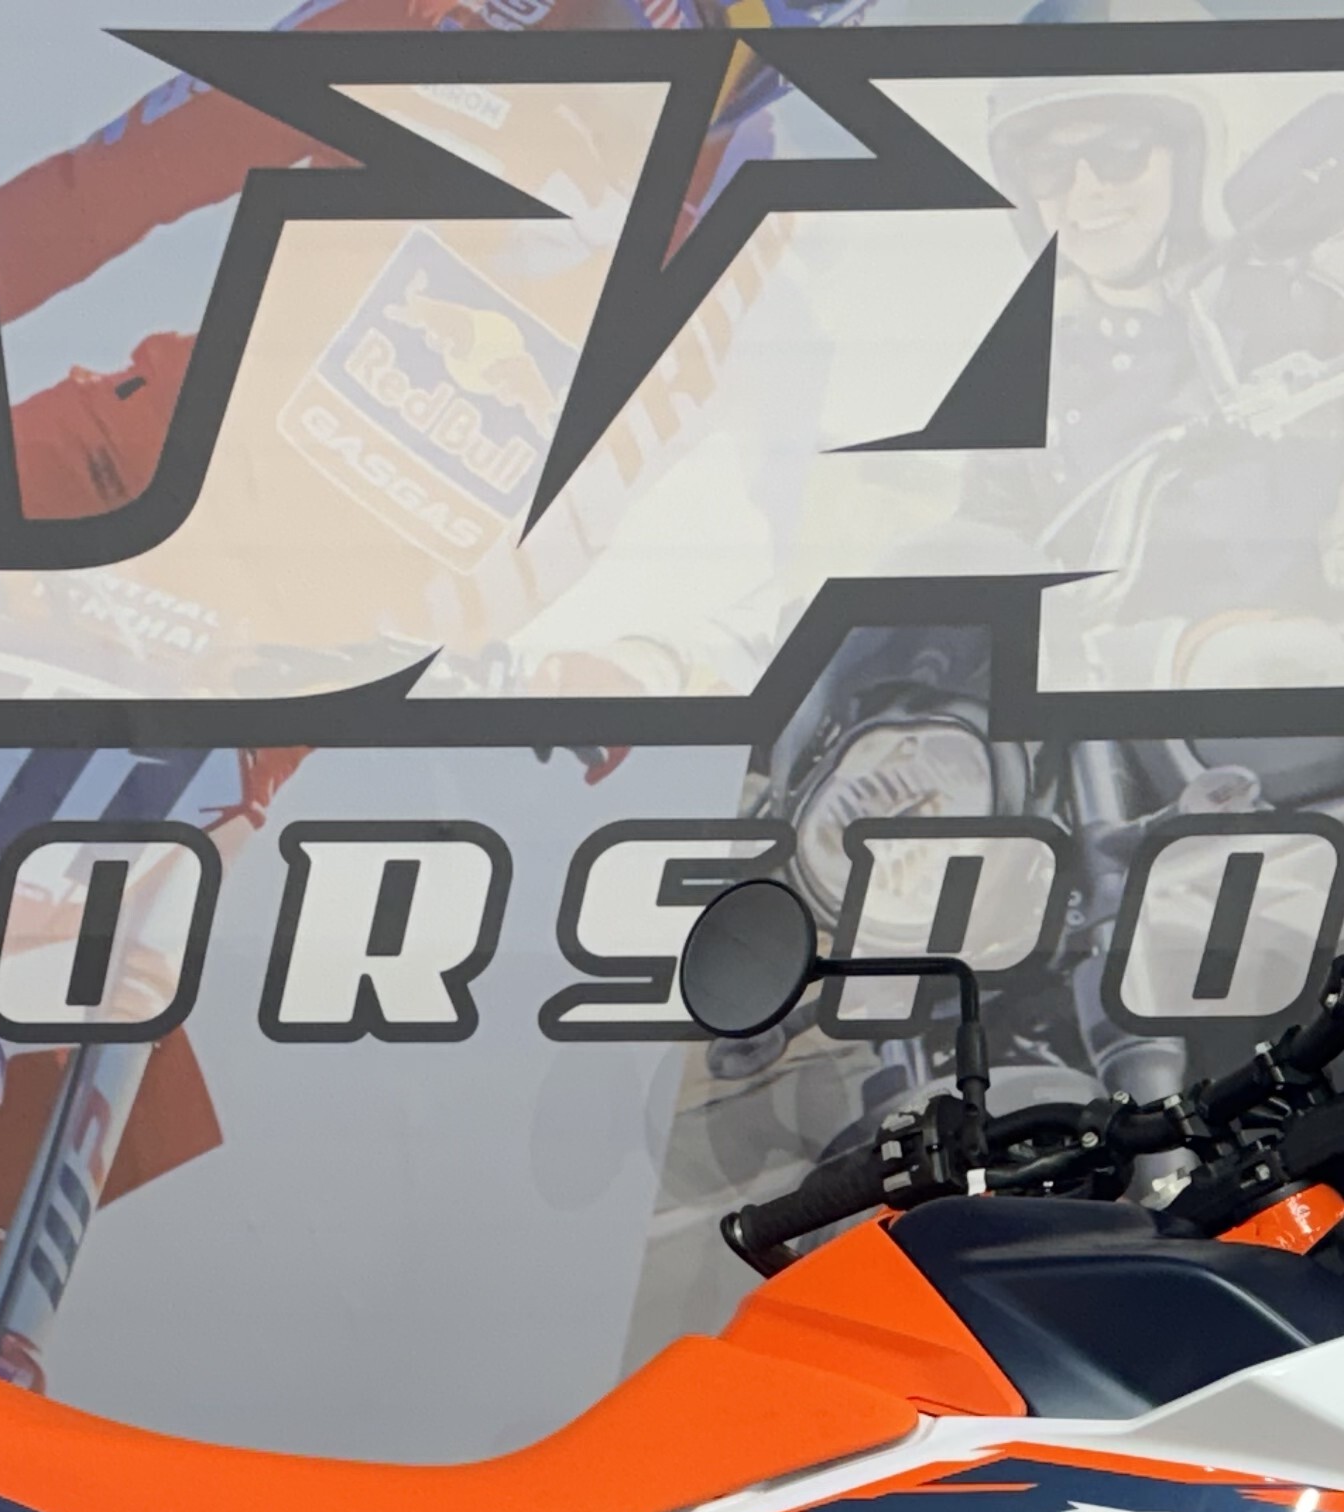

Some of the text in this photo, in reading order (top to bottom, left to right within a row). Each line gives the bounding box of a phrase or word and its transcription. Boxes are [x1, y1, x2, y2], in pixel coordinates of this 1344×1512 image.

[302, 404, 482, 548] GASGAS
[344, 326, 538, 494] Red Bull
